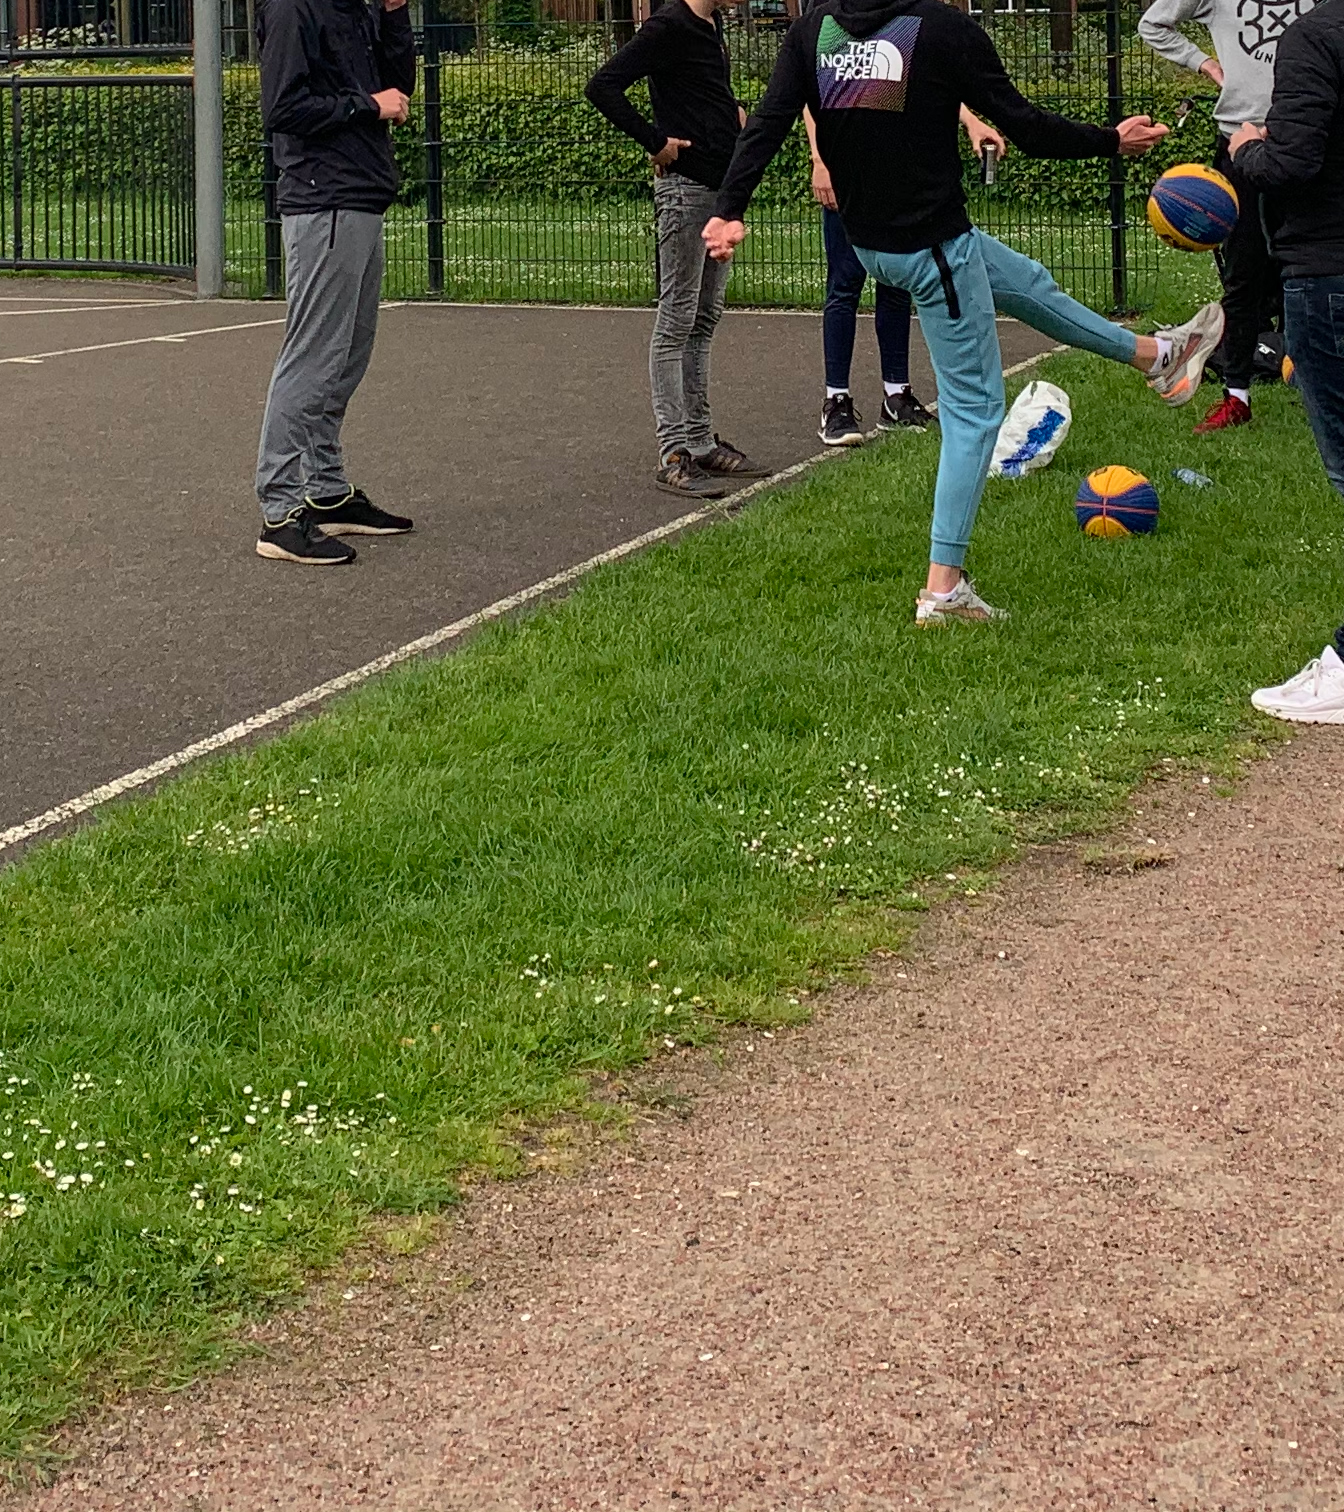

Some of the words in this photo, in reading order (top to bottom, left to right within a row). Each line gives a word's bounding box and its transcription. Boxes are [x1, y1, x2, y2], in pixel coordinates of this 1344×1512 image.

[847, 40, 878, 54] THE
[820, 53, 875, 68] NORTH
[835, 65, 872, 81] FACE
